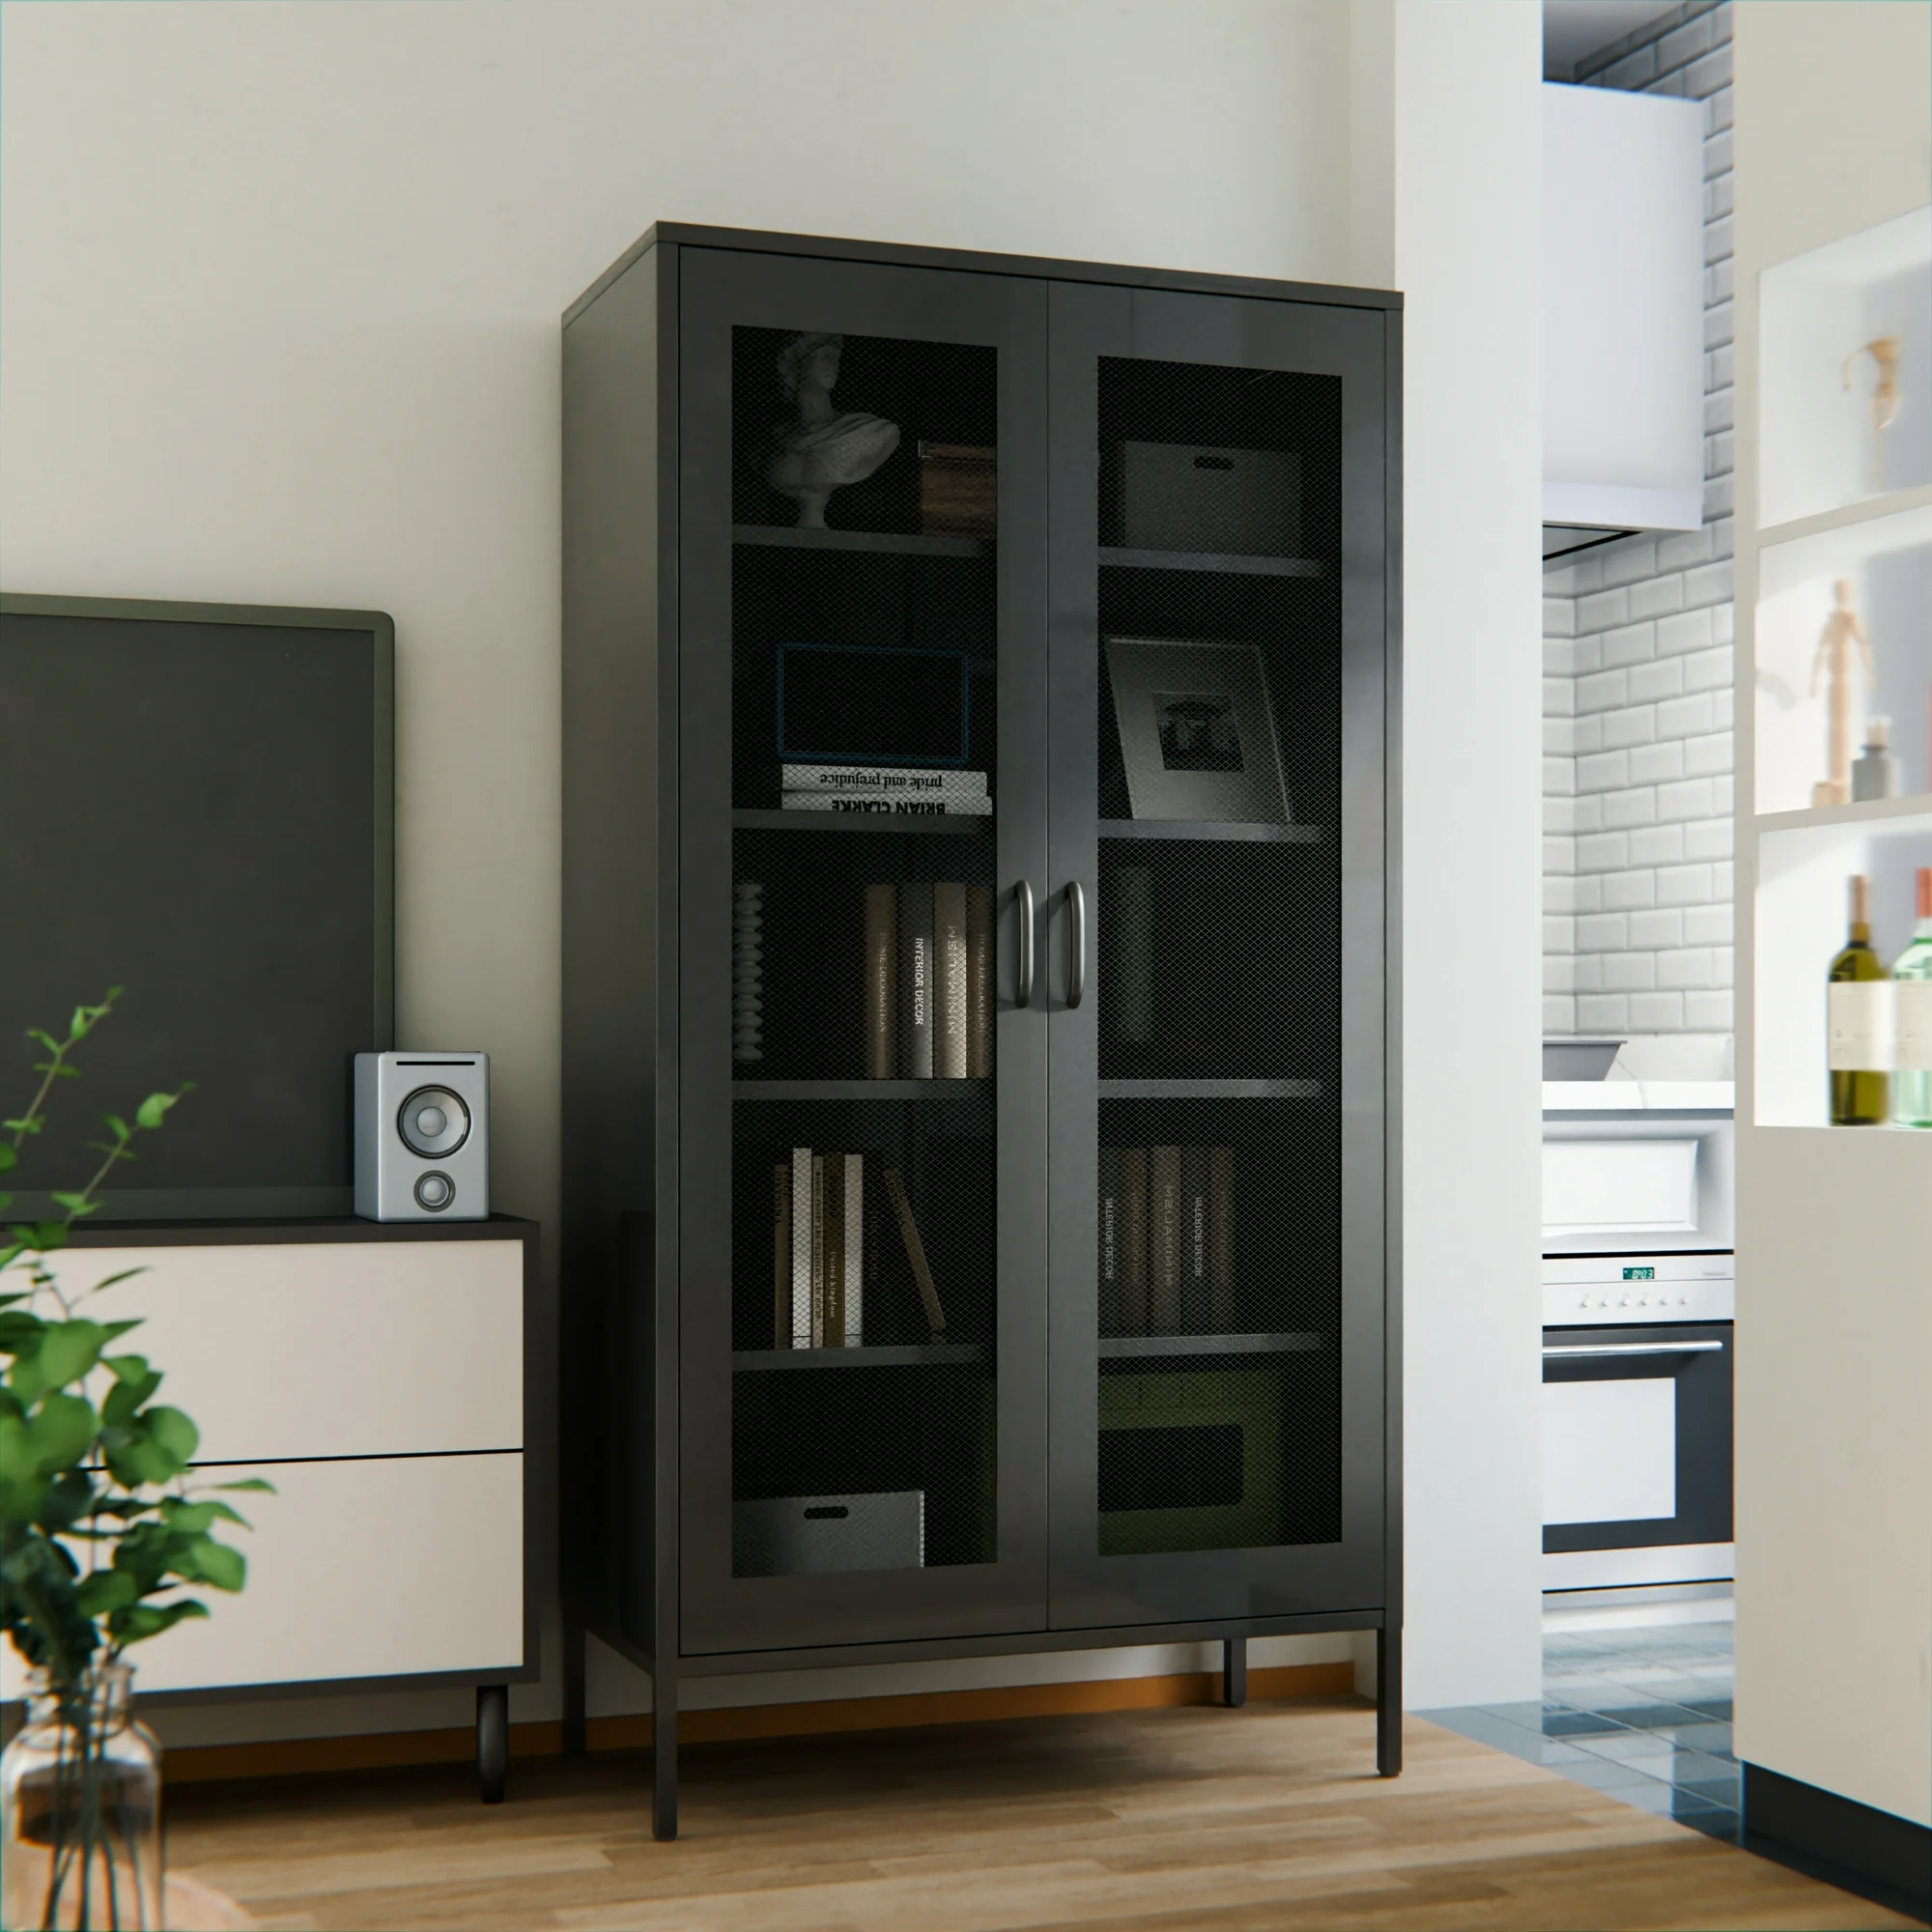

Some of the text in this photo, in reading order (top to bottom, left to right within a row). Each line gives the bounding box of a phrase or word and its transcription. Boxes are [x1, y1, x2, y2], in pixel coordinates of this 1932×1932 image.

[819, 773, 943, 790] pride and prejudice
[832, 800, 946, 815] BRIAN CLARKE
[914, 937, 923, 1026] INTERIOR DECOR
[828, 1251, 838, 1319] United Kingdom
